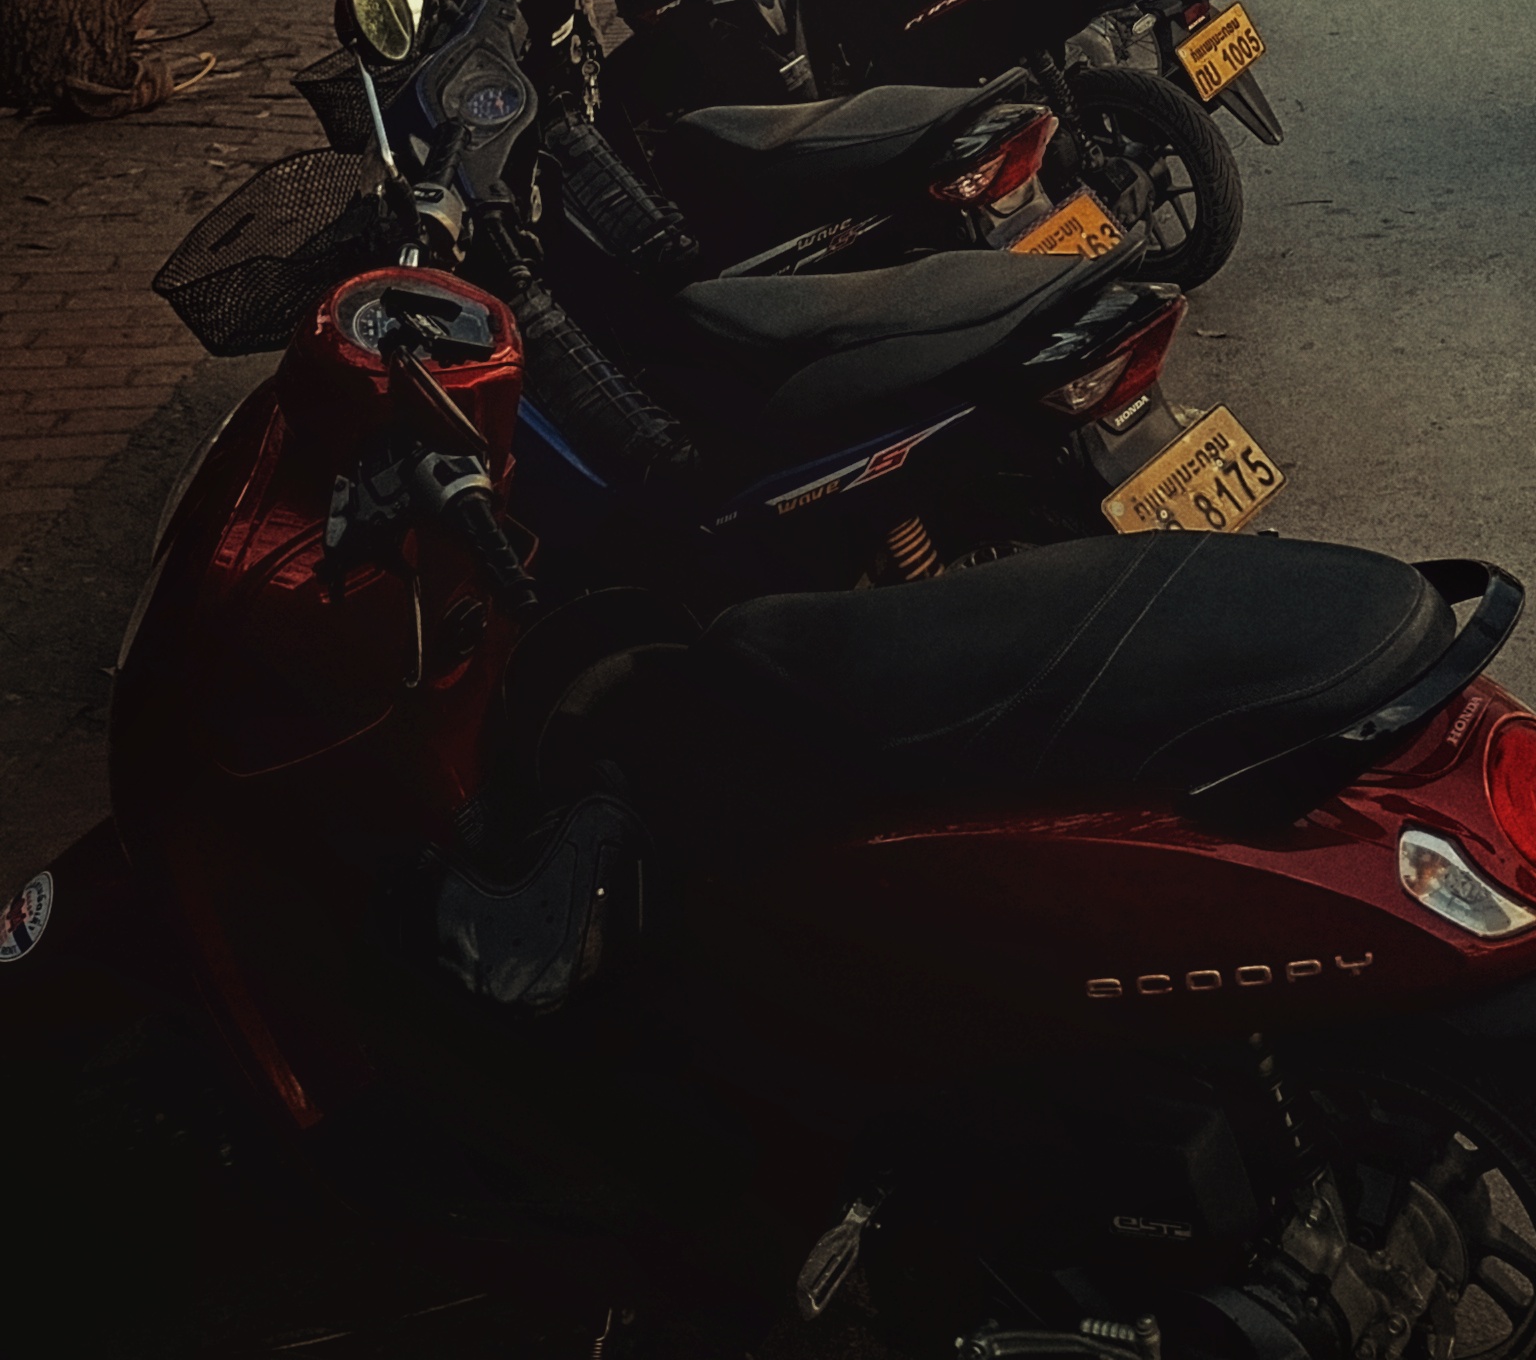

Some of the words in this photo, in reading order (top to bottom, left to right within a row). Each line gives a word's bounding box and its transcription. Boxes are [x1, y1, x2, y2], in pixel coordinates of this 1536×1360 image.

[1195, 60, 1222, 95] ກບ
[1222, 27, 1261, 72] 1005
[1114, 395, 1150, 427] HONDA
[776, 478, 841, 516] wave
[1194, 446, 1275, 530] 8175
[1446, 696, 1484, 748] HONDA
[1085, 951, 1374, 999] SCOOPY
